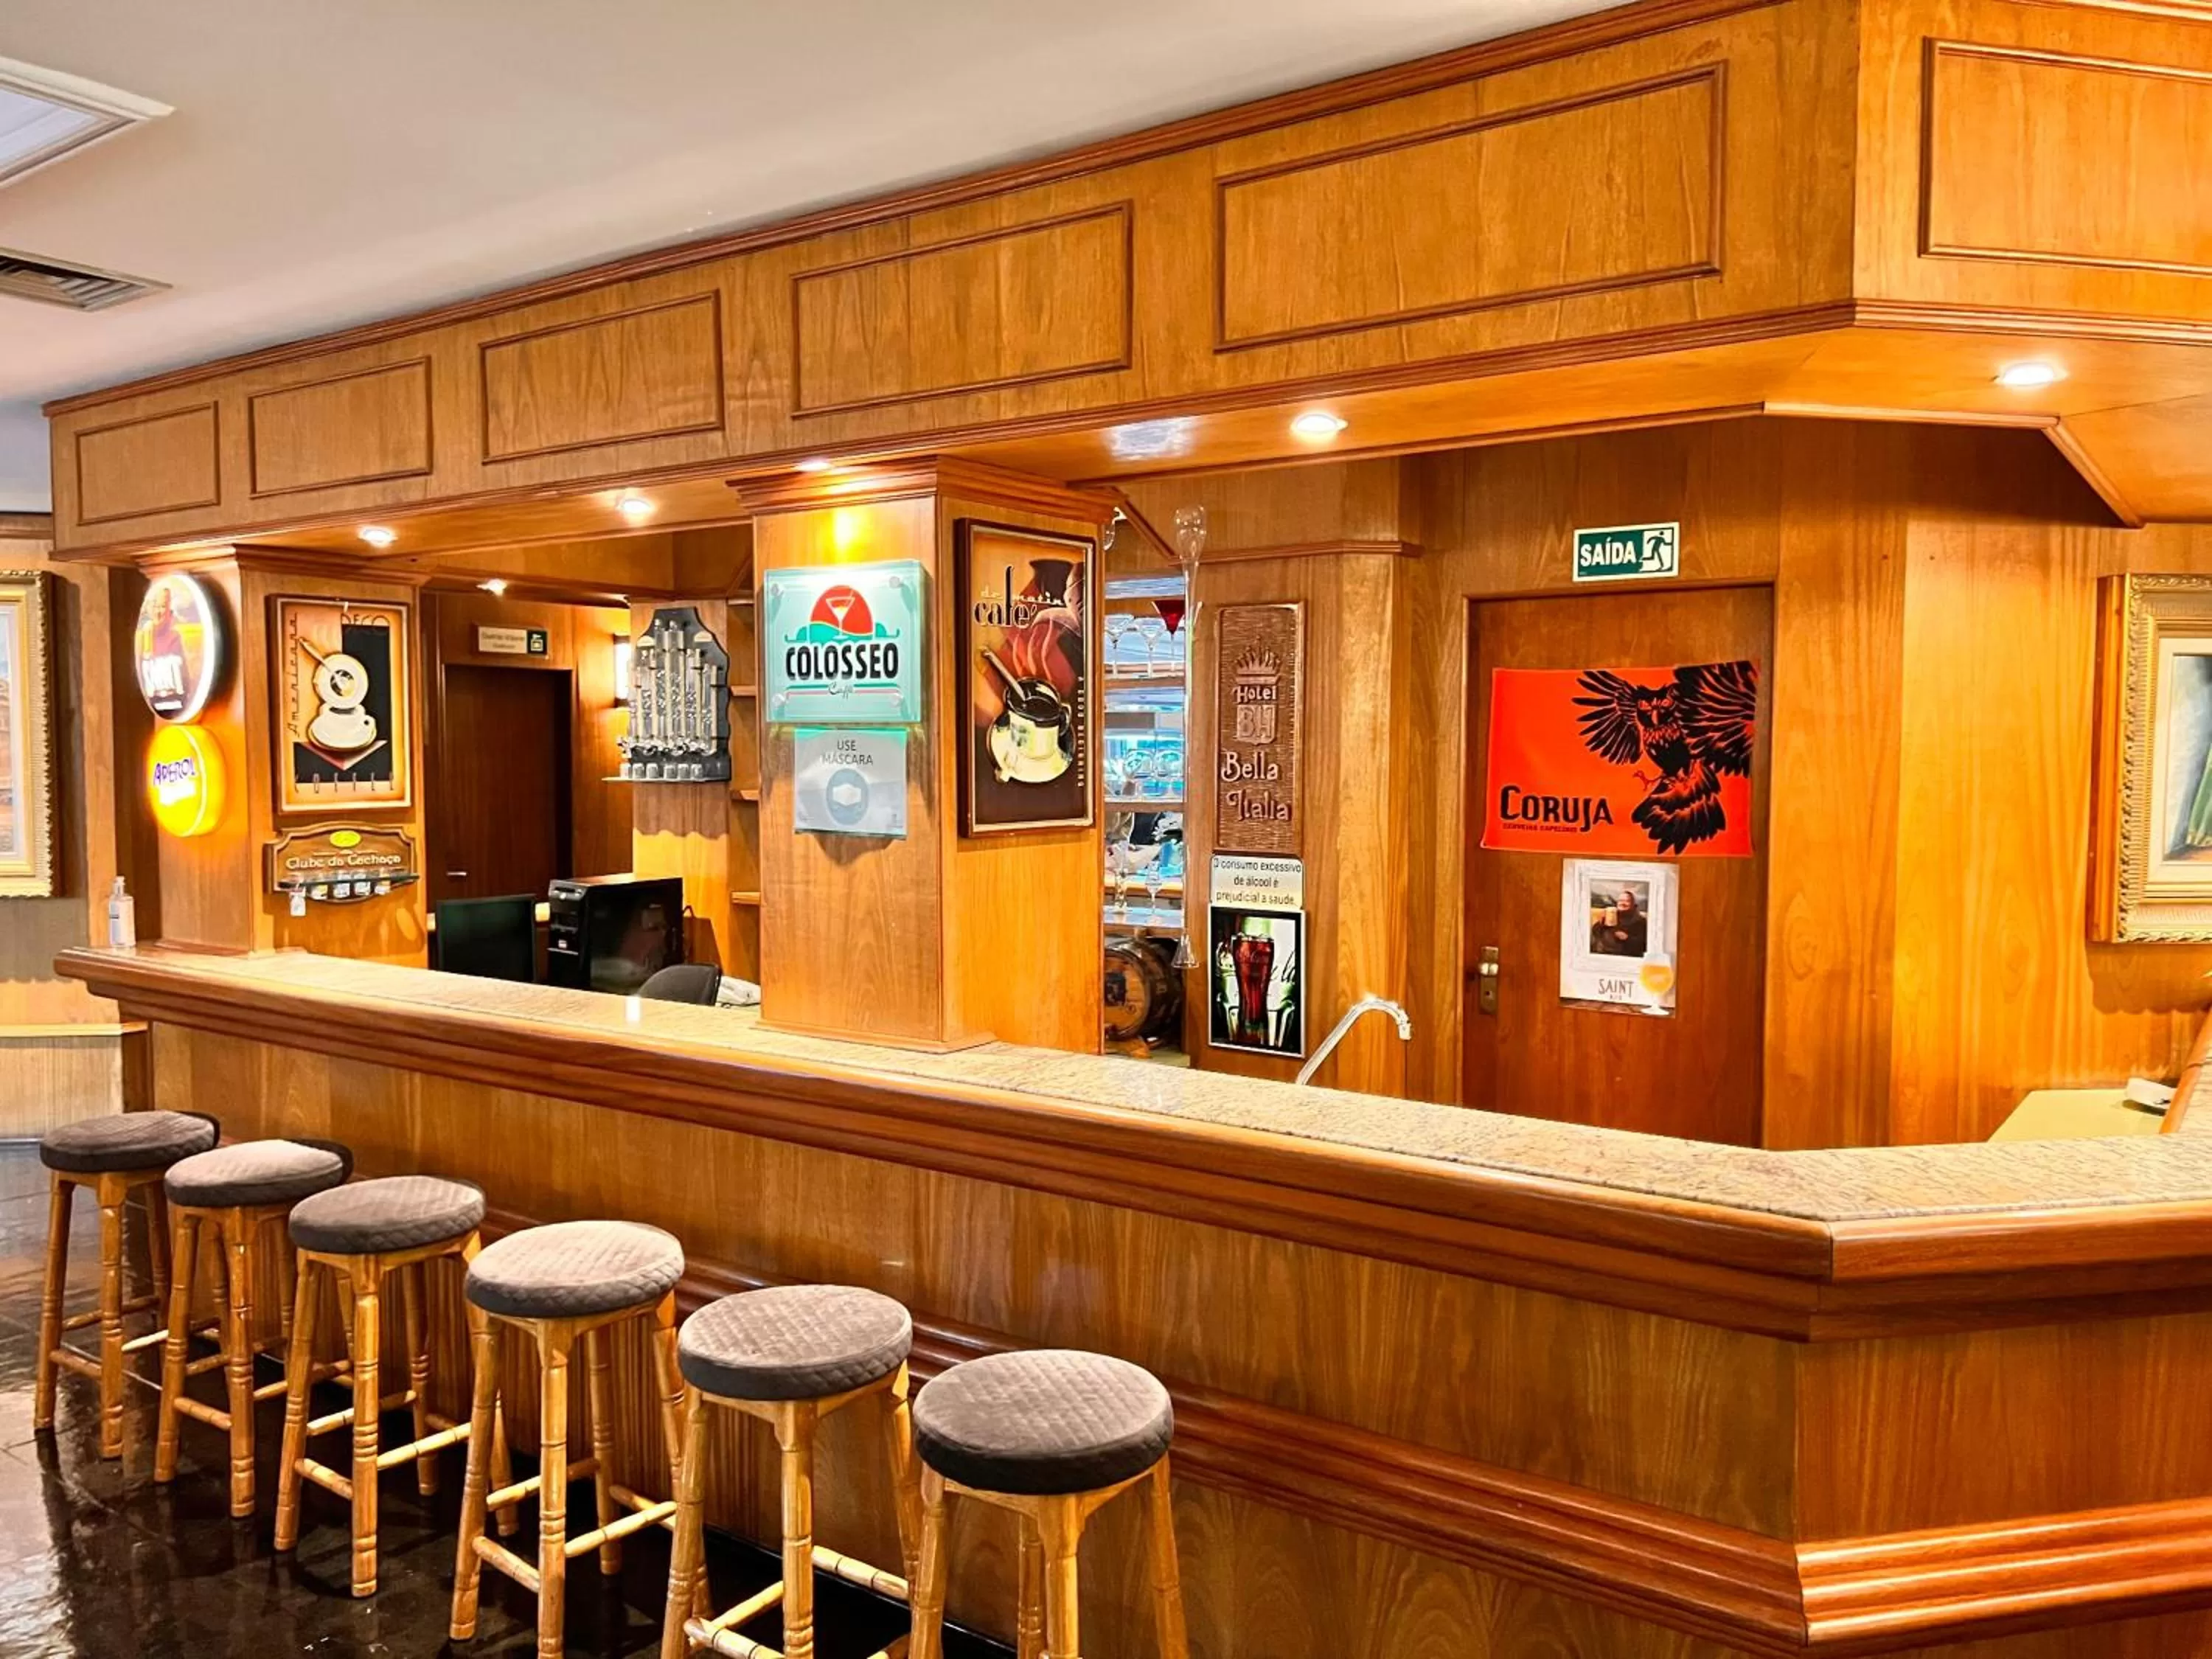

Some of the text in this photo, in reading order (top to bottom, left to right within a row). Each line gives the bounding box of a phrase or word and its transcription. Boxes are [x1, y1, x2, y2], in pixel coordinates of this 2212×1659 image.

[1580, 537, 1637, 567] SAÍDA
[785, 643, 899, 680] COLOSSEO
[1232, 685, 1276, 703] Hotel
[837, 740, 857, 751] USE
[153, 758, 196, 787] APEROL
[1221, 751, 1279, 782] Bella
[1221, 860, 1258, 870] consumo
[1260, 862, 1301, 873] excessivo
[1234, 874, 1244, 885] de
[1598, 978, 1635, 998] SAINT
